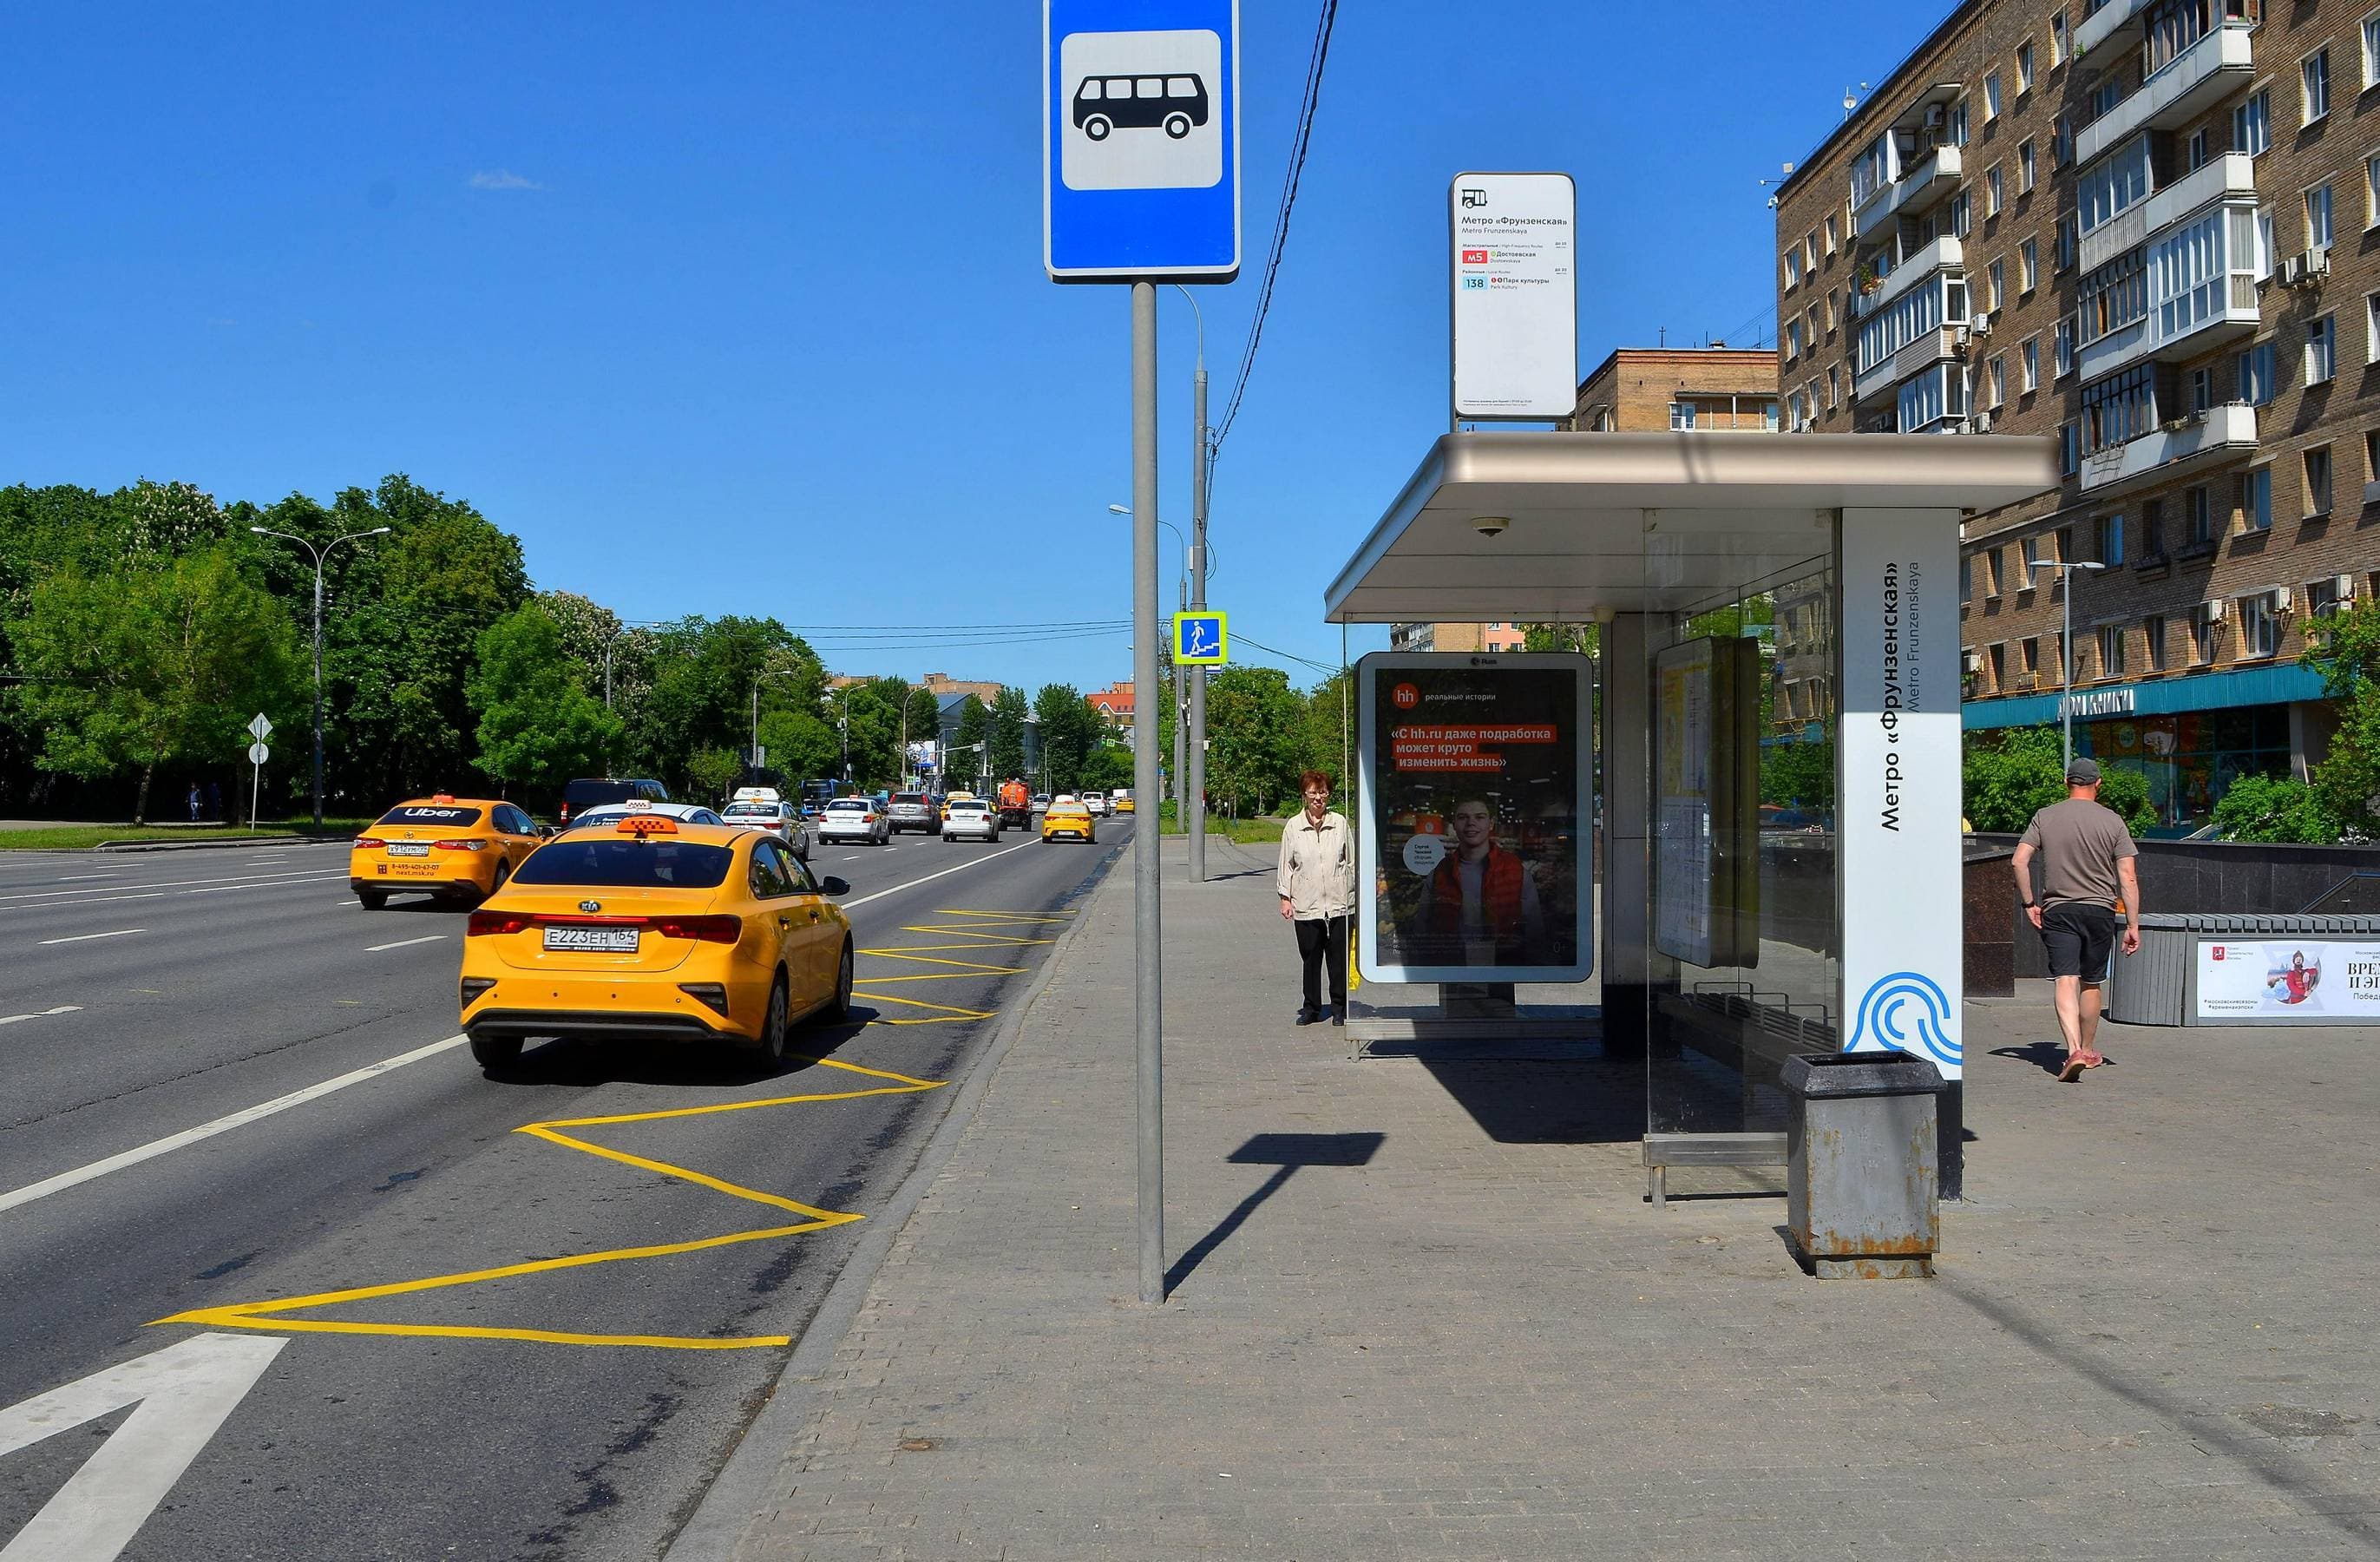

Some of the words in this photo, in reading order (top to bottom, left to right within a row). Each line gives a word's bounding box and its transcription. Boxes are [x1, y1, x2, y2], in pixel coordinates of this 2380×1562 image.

[1461, 216, 1493, 226] Метро
[1496, 217, 1567, 226] «Фрунзенская»
[1466, 279, 1484, 288] 138
[1905, 562, 1922, 661] Frunzenskaya
[1880, 562, 1903, 744] «Фрунзенская»
[1397, 689, 1413, 702] hh
[1907, 667, 1919, 712] Metro
[2090, 689, 2134, 716] КНИГИ
[1410, 728, 1442, 738] hh.ru
[1445, 730, 1477, 740] даже
[1479, 728, 1551, 741] подработка
[1396, 745, 1434, 753] может
[1438, 745, 1472, 755] круто
[1399, 758, 1458, 767] изменить
[1460, 758, 1507, 767] жизнь»
[1881, 753, 1903, 831] Метро
[404, 808, 462, 817] Uber
[581, 902, 598, 911] KIA
[613, 929, 635, 941] 164
[2348, 962, 2380, 975] ВРЕ
